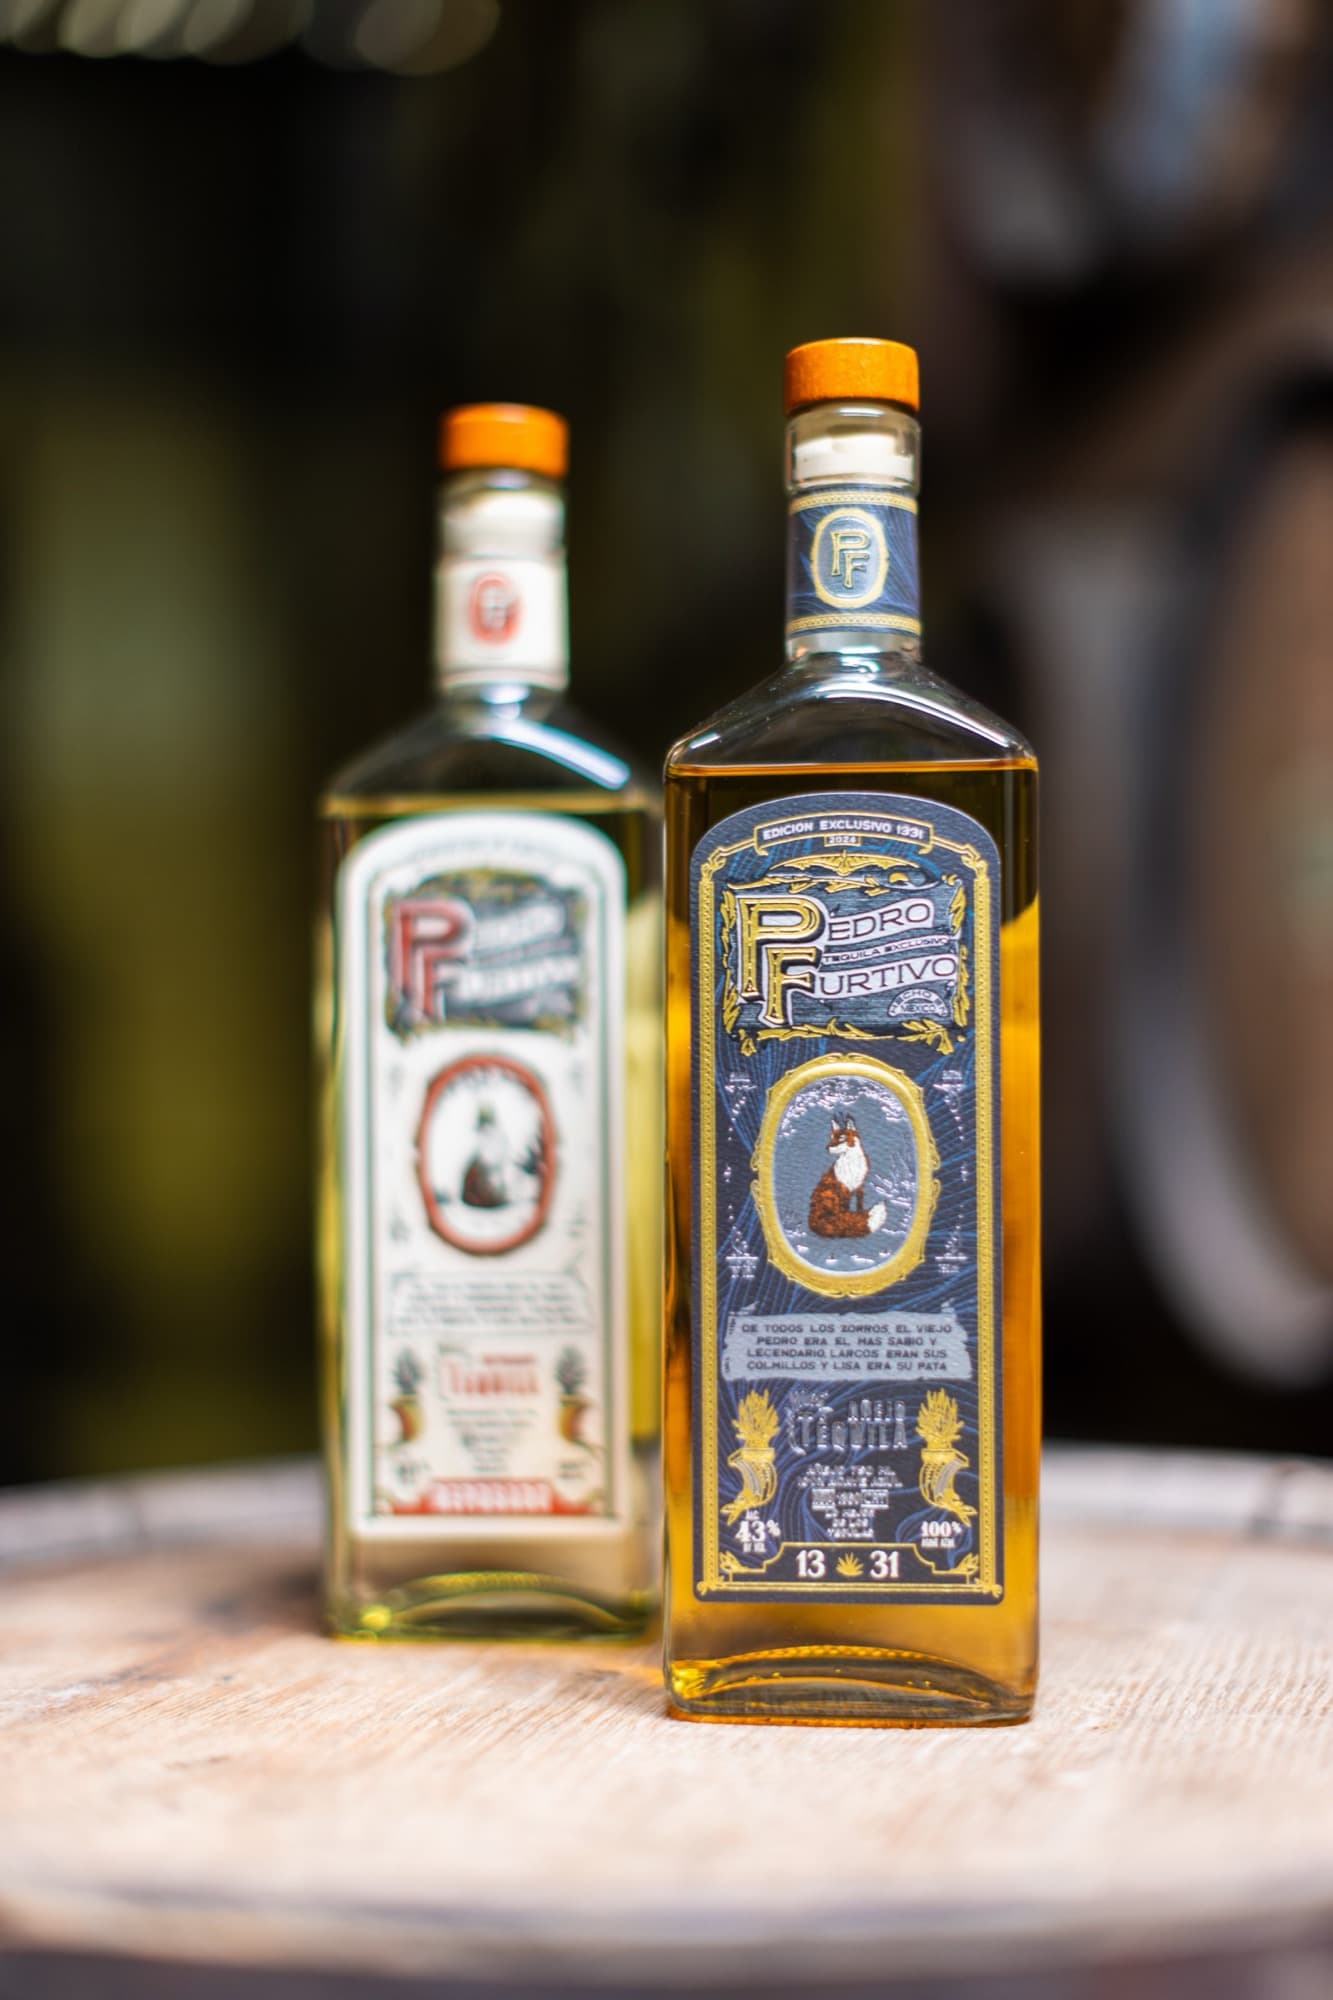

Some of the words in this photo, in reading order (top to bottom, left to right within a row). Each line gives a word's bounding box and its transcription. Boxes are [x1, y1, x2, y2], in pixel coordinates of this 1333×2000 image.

[762, 822, 813, 840] EDICION
[819, 820, 892, 833] EXCLUSIVO
[896, 825, 925, 840] 1331
[823, 948, 881, 962] TEQUILA
[884, 937, 949, 953] EXCLUSIVO
[742, 1324, 758, 1333] DE
[765, 1324, 803, 1333] TODOS
[810, 1324, 834, 1333] LOS
[896, 1324, 911, 1333] EL
[916, 1324, 952, 1333] VIEJO
[757, 1336, 797, 1345] PEDRO
[804, 1336, 827, 1345] ERA
[835, 1336, 850, 1345] EL
[888, 1336, 923, 1345] SABIO
[930, 1337, 937, 1345] Y
[886, 1349, 918, 1358] ERAN
[923, 1349, 947, 1358] SUS
[747, 1361, 816, 1370] COLMILLOS
[821, 1361, 828, 1370] Y
[867, 1361, 891, 1370] ERA
[897, 1361, 912, 1370] SU
[918, 1361, 947, 1370] PATA
[735, 1520, 781, 1542] 43%
[921, 1520, 963, 1537] 100%
[796, 1549, 826, 1578] 13
[870, 1549, 899, 1578] 31
